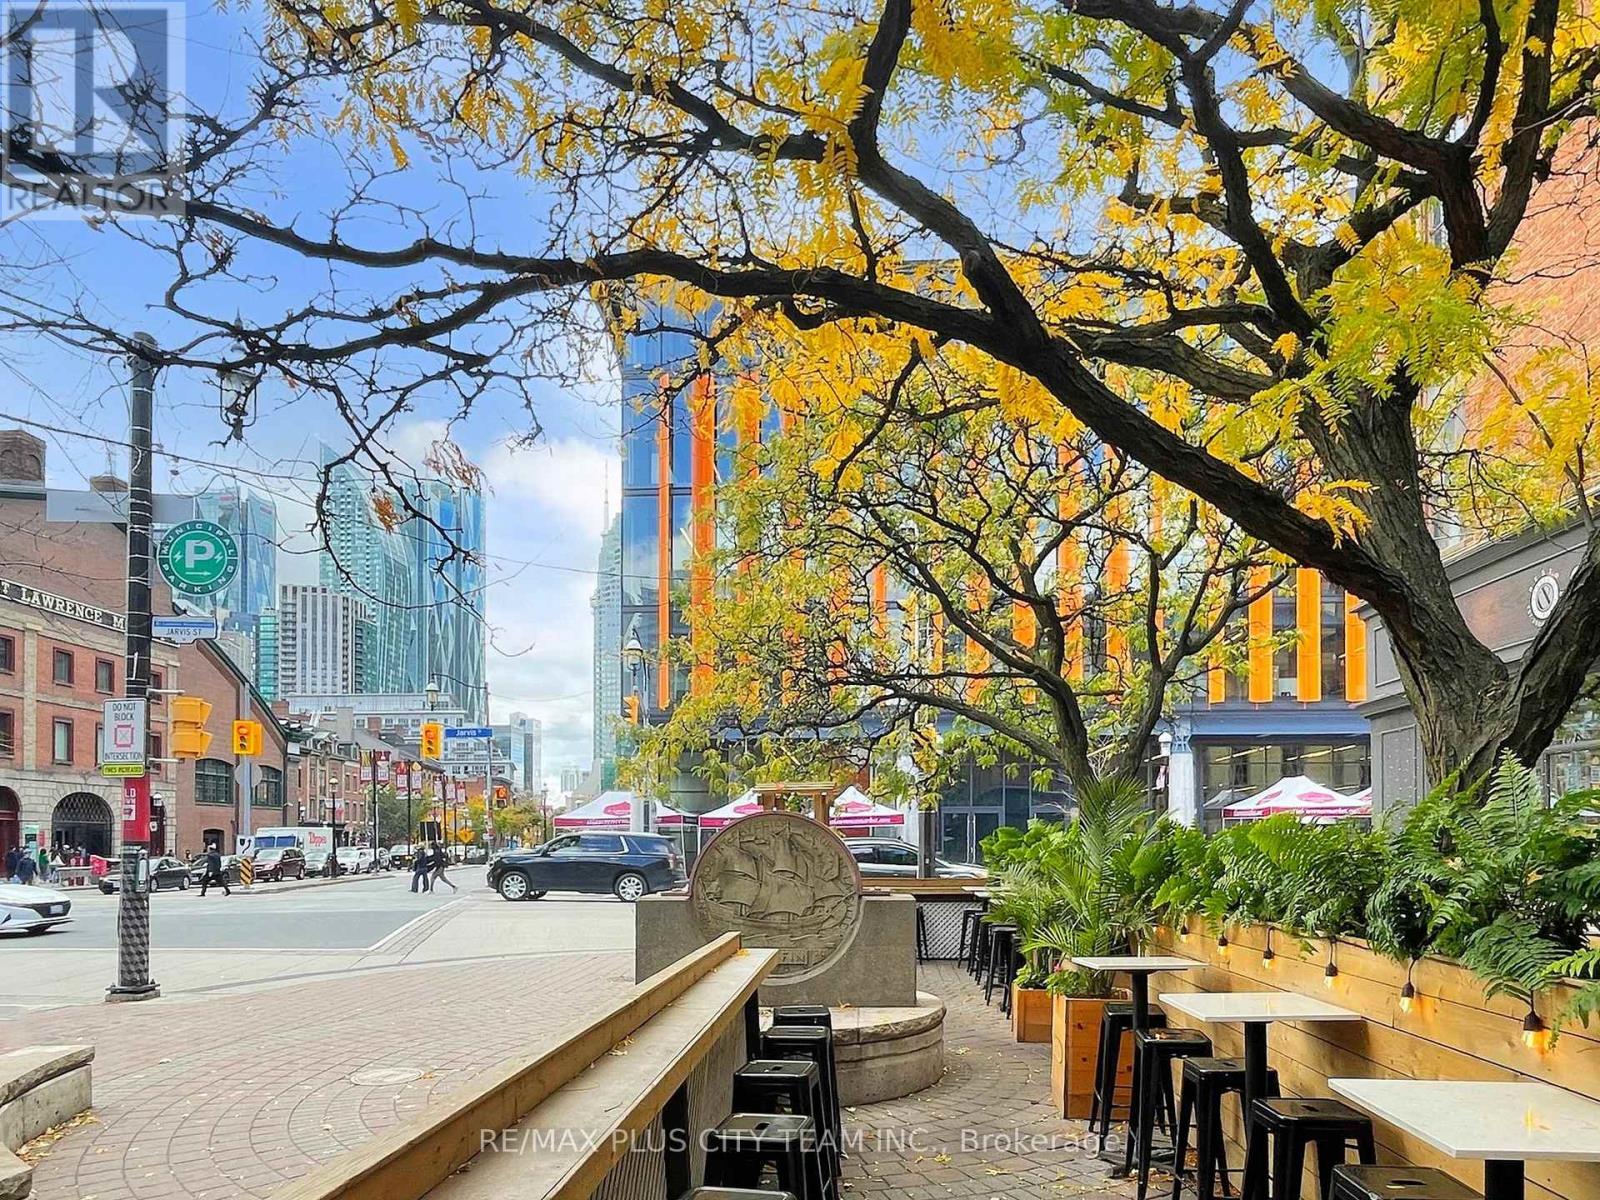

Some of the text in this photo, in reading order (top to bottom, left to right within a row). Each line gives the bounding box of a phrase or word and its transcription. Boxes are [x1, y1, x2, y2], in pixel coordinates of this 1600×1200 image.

[161, 522, 236, 556] MUNICIPAL
[184, 539, 216, 569] P
[162, 563, 235, 593] PARKING
[20, 586, 103, 623] LAWRENCE
[166, 628, 202, 636] JARVIS ST
[112, 702, 136, 712] DO NOT
[114, 712, 134, 721] BLOCK
[455, 729, 477, 737] Jarvis
[104, 751, 143, 760] INTERSECTION
